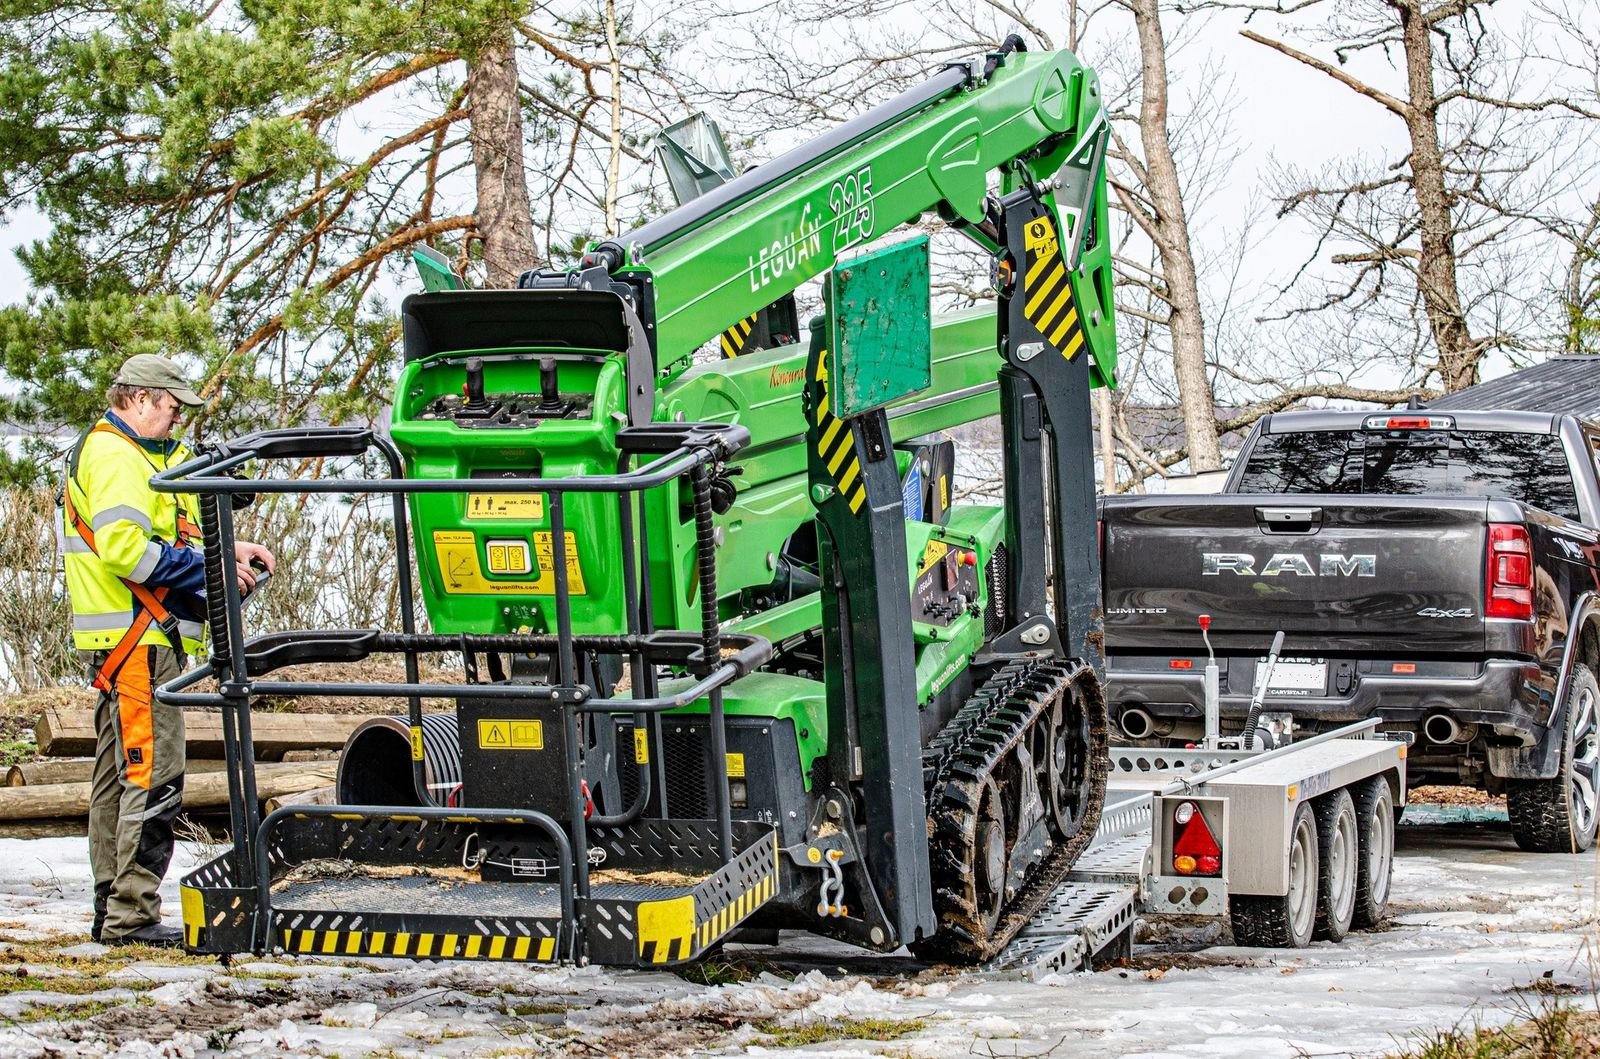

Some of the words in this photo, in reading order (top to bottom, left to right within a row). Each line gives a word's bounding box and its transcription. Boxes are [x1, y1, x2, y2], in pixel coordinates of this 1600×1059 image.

[829, 165, 876, 256] 225
[1201, 553, 1377, 577] RAM
[1416, 607, 1475, 618] 4x4
